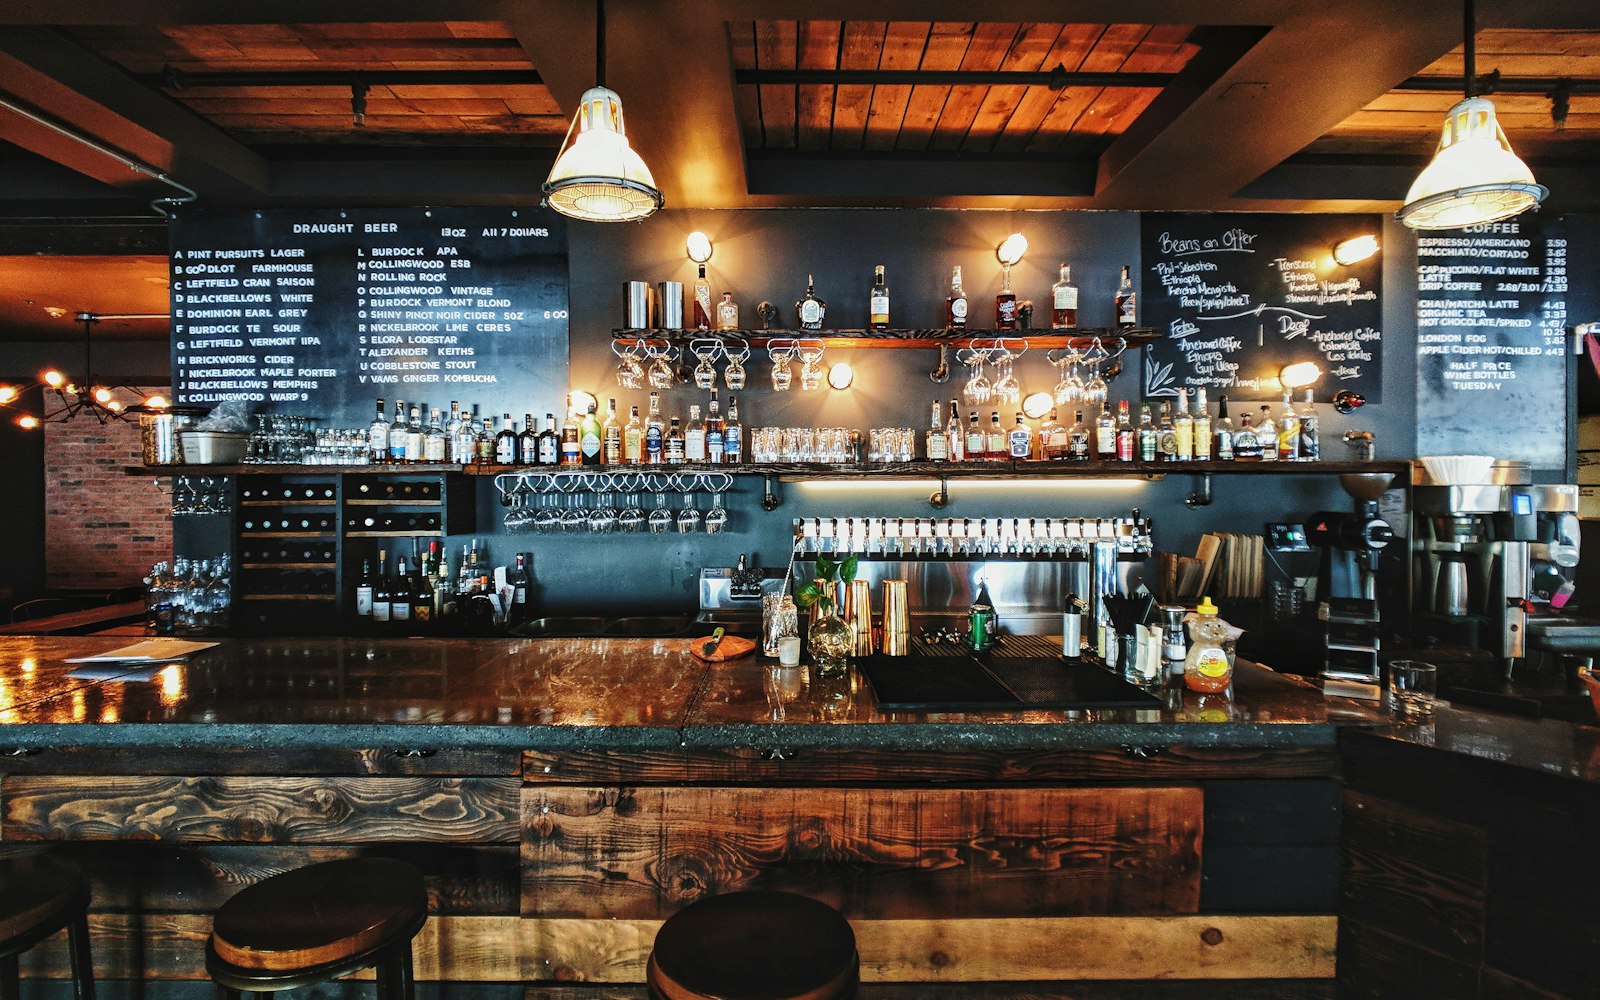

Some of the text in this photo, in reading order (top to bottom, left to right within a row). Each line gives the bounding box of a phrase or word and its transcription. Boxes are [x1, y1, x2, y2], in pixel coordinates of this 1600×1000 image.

[293, 223, 398, 233] DRAUGHT BEER
[501, 228, 507, 237] 7
[1463, 223, 1520, 234] COFFEE
[1159, 228, 1257, 253] Beans on Offer
[1418, 238, 1567, 248] ESPRESSO/AMERICANO 3.50
[174, 249, 305, 259] A PINT PURSUITS LAGER
[372, 247, 424, 256] BURDOCK
[437, 247, 458, 255] APA
[1418, 248, 1566, 259] MACCHIATO/CORTADO 3.82
[357, 260, 471, 270] M COLLINGWOOD ESB
[1546, 258, 1566, 266] 3.95
[175, 266, 183, 274] B
[252, 264, 313, 273] FARMHOUSE
[1418, 266, 1566, 275] CAPPUCCINO/FLAT WHITE 3.98
[358, 273, 447, 282] N ROLLING ROCK
[1162, 274, 1201, 286] Ethiopia
[1418, 274, 1567, 284] LATTE 4.30
[174, 278, 315, 290] C LEFTFIELD CRAN SAISON
[1418, 282, 1443, 291] DRIP
[1444, 282, 1482, 291] COFFEE
[357, 286, 493, 296] O COLLINGWOOD VINTAGE
[176, 294, 314, 304] D BLACKBELLOWS WHITE
[359, 299, 511, 308] P BURDOCK VERMONT BLOND
[1418, 300, 1487, 309] CHAI/MATCHA
[1489, 300, 1519, 308] LATTE
[176, 309, 183, 318] E
[187, 309, 241, 318] DOMINION
[278, 309, 308, 318] GREY
[358, 311, 367, 319] Q
[371, 311, 402, 319] SHINY
[406, 311, 434, 320] PINOT
[437, 311, 461, 319] NOIR
[464, 312, 495, 320] CIDER
[1418, 310, 1464, 318] ORGANIC
[1466, 310, 1487, 318] TEA
[1418, 318, 1440, 327] HOT
[1440, 317, 1531, 328] CHOCOLATE/SPIKED
[176, 325, 183, 333] F
[189, 325, 239, 334] BURDOCK
[359, 324, 366, 332] R
[371, 324, 439, 332] NICKELBROOK
[359, 336, 457, 344] S ELORA LODESTAR
[1418, 335, 1461, 343] LONDON
[1464, 335, 1487, 343] FOG
[177, 342, 185, 350] G
[190, 339, 243, 348] LEFTFIELD
[250, 338, 296, 347] VERMONT
[359, 348, 474, 357] T ALEXANDER KEITHS
[1418, 346, 1450, 355] APPLE
[1452, 346, 1483, 355] CIDER
[1484, 346, 1542, 355] HOT/CHILLED
[178, 356, 295, 364] H BRICKWORKS CIDER
[360, 361, 477, 370] U COBBLESTONE STOUT
[1450, 362, 1478, 370] HALF
[179, 368, 337, 378] I NICKELBROOK MAPLE PORTER
[1444, 371, 1516, 379] WINE BOTTLES
[359, 375, 367, 384] V
[403, 375, 440, 383] GINGER
[444, 375, 497, 383] KOMBUCHA
[179, 381, 318, 390] J BLACKBELLOWS MEMPHIS
[1452, 382, 1501, 390] TUESDAY
[179, 394, 186, 402] K
[189, 393, 264, 402] COLLINGWOOD
[270, 393, 299, 401] WARP
